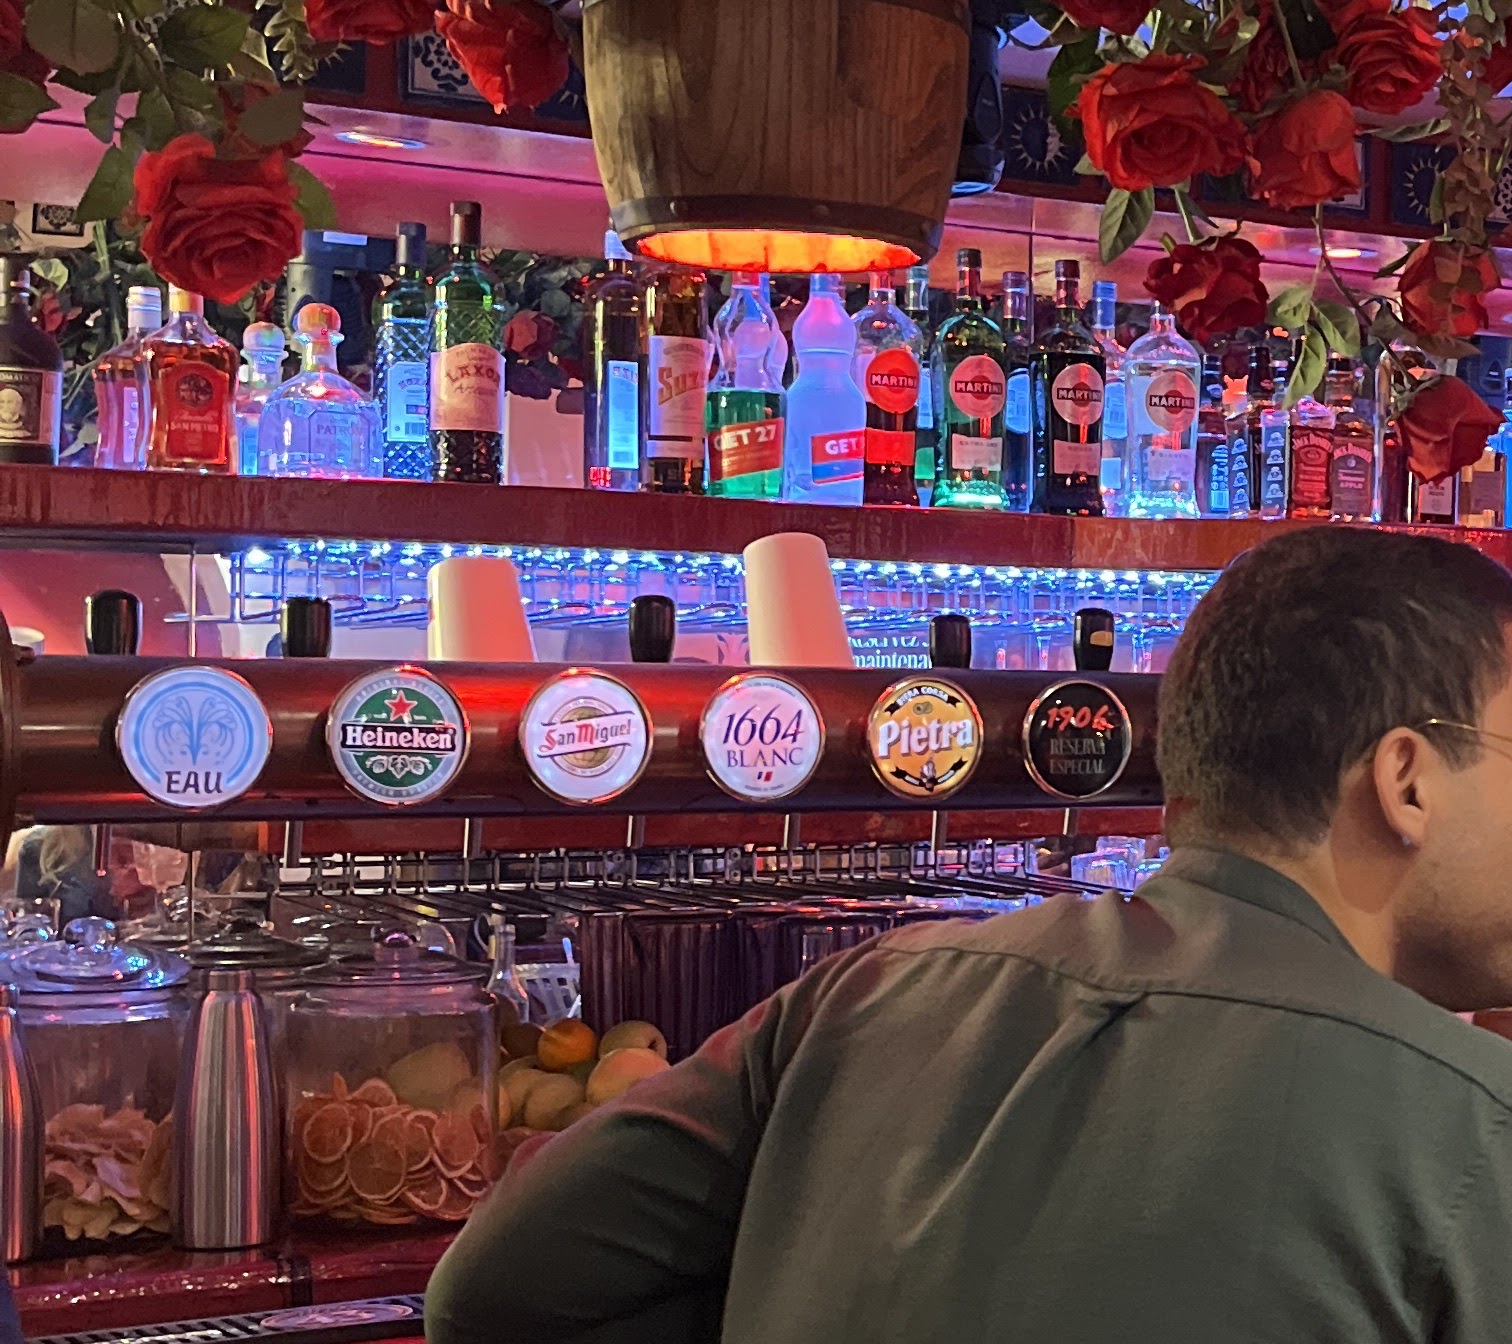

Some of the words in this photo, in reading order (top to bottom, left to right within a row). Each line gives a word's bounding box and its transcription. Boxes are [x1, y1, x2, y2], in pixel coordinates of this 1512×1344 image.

[713, 429, 751, 451] GET
[755, 425, 777, 442] 27
[345, 726, 453, 749] Heineken
[538, 729, 576, 753] San
[575, 719, 632, 745] Miguel
[722, 703, 805, 746] 1664
[878, 719, 974, 758] Pietra
[726, 747, 804, 768] BLANC
[165, 770, 223, 794] EAU
